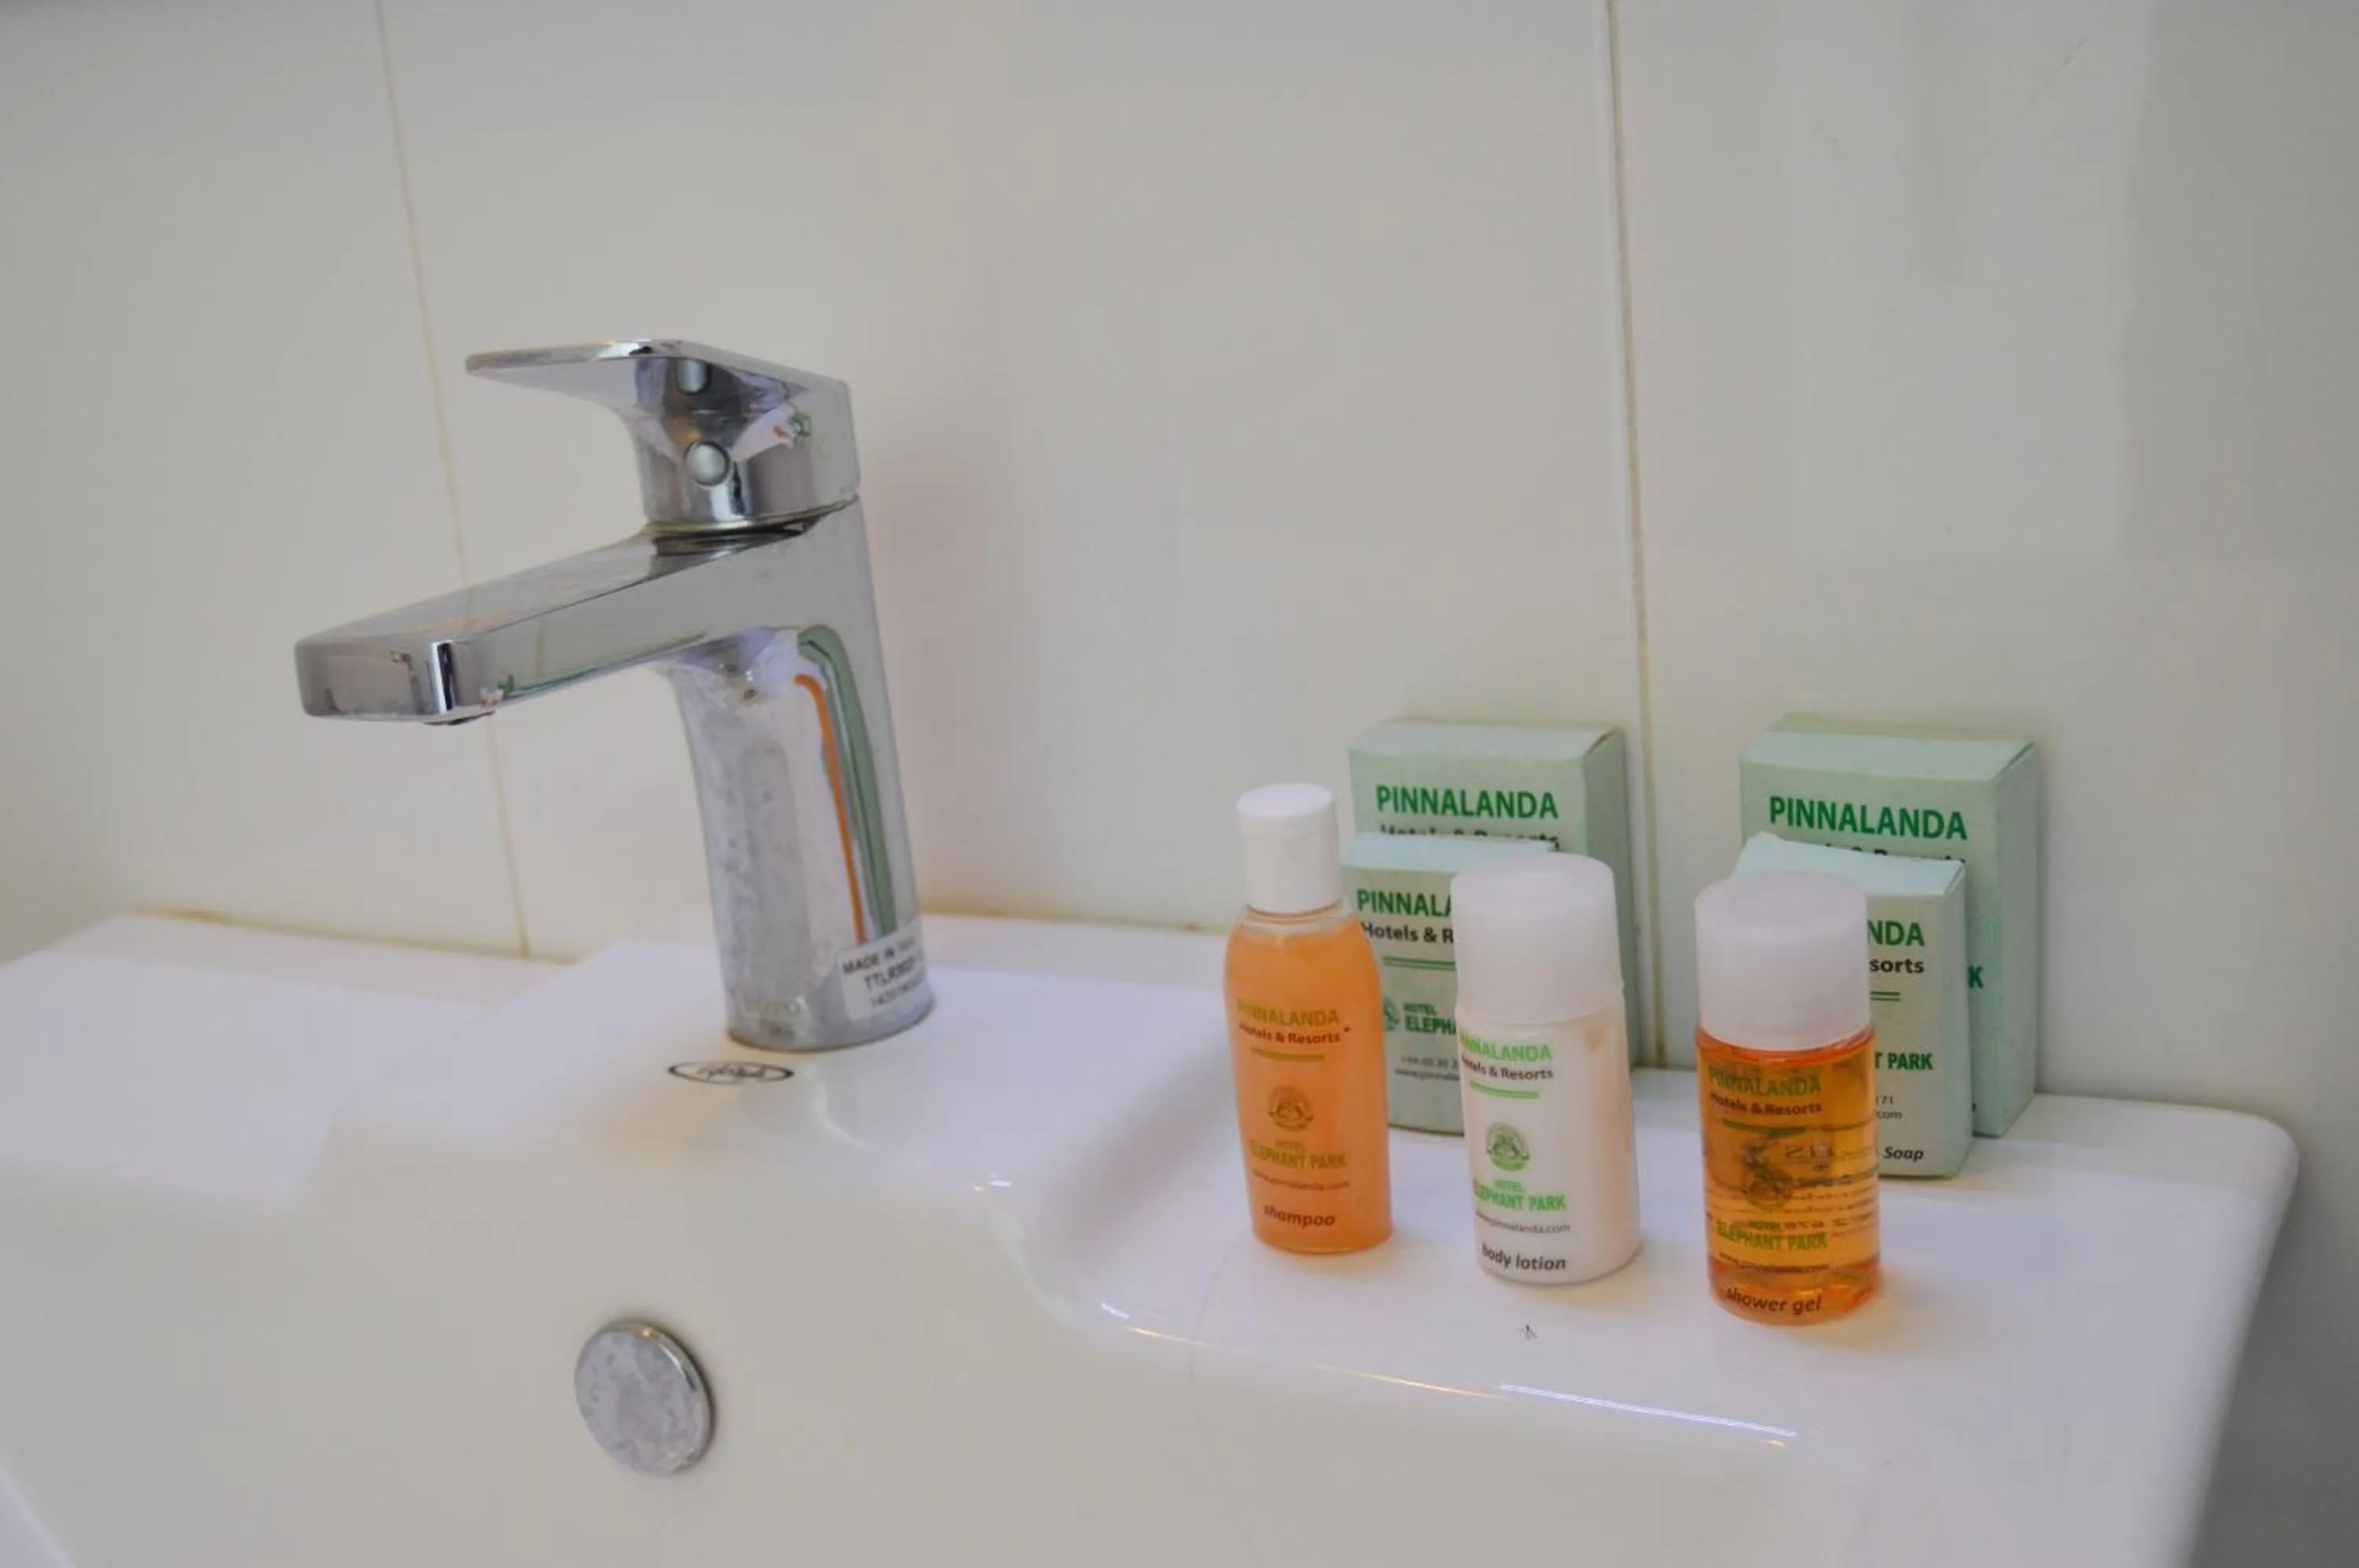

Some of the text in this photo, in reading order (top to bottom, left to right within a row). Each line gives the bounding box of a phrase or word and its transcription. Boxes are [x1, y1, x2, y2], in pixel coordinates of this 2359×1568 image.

[1376, 785, 1559, 819] PINNALANDA
[1769, 796, 1967, 841] PINNALANDA
[1356, 888, 1452, 918] PINNAL
[1360, 921, 1419, 942] Hotels
[1424, 926, 1437, 943] &
[842, 951, 879, 974] MADE
[1404, 1015, 1456, 1036] ELEPH
[1275, 1031, 1286, 1044] &
[1288, 1032, 1340, 1044] Resorts
[1460, 1031, 1553, 1062] NNALANDA
[1887, 1051, 1934, 1070] PARK
[1489, 1066, 1498, 1078] &
[1500, 1066, 1554, 1080] Resorts
[1751, 1102, 1763, 1115] &
[1765, 1103, 1823, 1115] Resorts
[1309, 1151, 1347, 1169] PARK
[1883, 1146, 1924, 1163] Soap
[1529, 1194, 1566, 1211] PARK
[1264, 1204, 1335, 1229] shampoo
[1787, 1232, 1827, 1250] PARK
[1481, 1242, 1566, 1271] body lotion
[1725, 1287, 1822, 1316] shower gel
